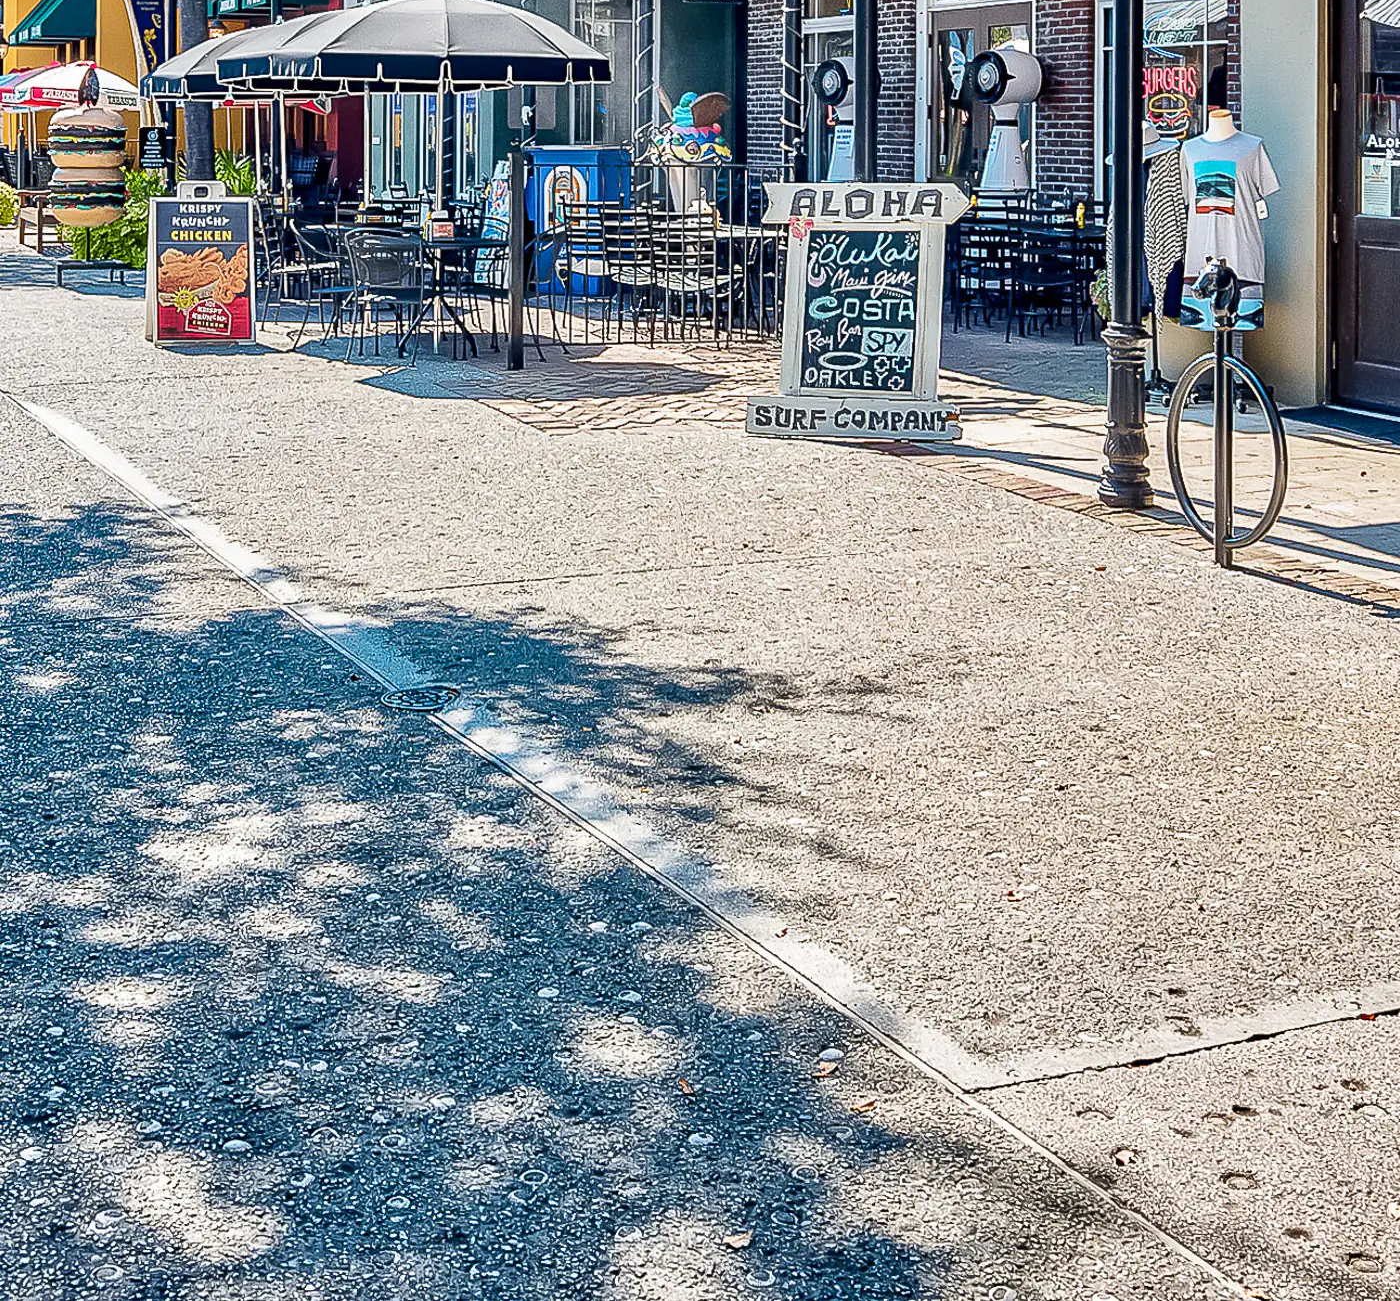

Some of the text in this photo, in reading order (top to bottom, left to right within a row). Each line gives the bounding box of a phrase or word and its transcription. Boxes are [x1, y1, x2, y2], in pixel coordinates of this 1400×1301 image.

[1142, 66, 1196, 99] BURGERS
[179, 203, 222, 214] KRISPY
[789, 188, 943, 219] ALOHA
[172, 216, 230, 227] KRUNCHY
[170, 230, 232, 241] CHICKEN
[808, 295, 915, 322] COSTA
[805, 318, 861, 353] Ray Ban
[866, 330, 908, 353] SPY
[804, 367, 889, 388] OAKLEY
[754, 405, 949, 432] SURF COMPANY
